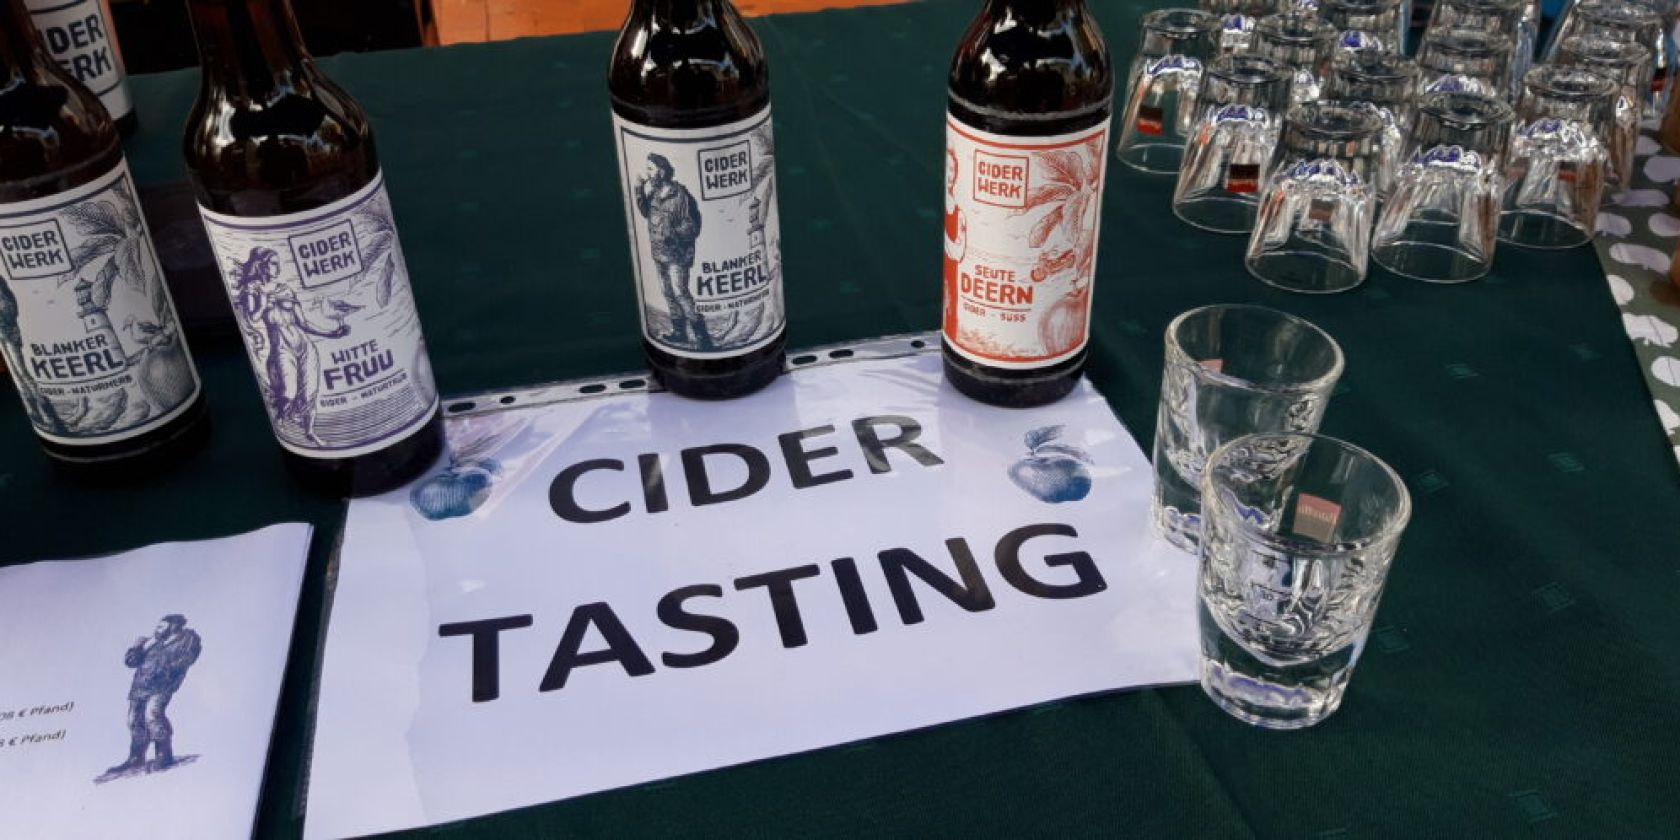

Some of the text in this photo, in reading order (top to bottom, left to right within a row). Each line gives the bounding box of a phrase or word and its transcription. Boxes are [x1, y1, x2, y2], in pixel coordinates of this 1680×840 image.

[45, 14, 103, 54] DER
[704, 152, 747, 173] CIDER
[978, 161, 1023, 181] CIDER
[706, 171, 749, 190] WERK
[977, 176, 1021, 197] WERK
[1, 230, 59, 251] CIDER
[299, 231, 352, 259] CIDER
[7, 248, 65, 270] WERK
[302, 250, 356, 278] WERK
[702, 249, 762, 274] BLANKER
[697, 265, 769, 297] KEERL
[975, 264, 1016, 282] SEUTE
[960, 272, 1034, 305] DEERN
[31, 334, 109, 358] BLANKER
[331, 339, 379, 364] WITTE
[31, 348, 125, 380] KEERL
[323, 349, 395, 391] FRUU
[548, 414, 944, 524] CIDER
[438, 522, 1108, 703] TASTING
